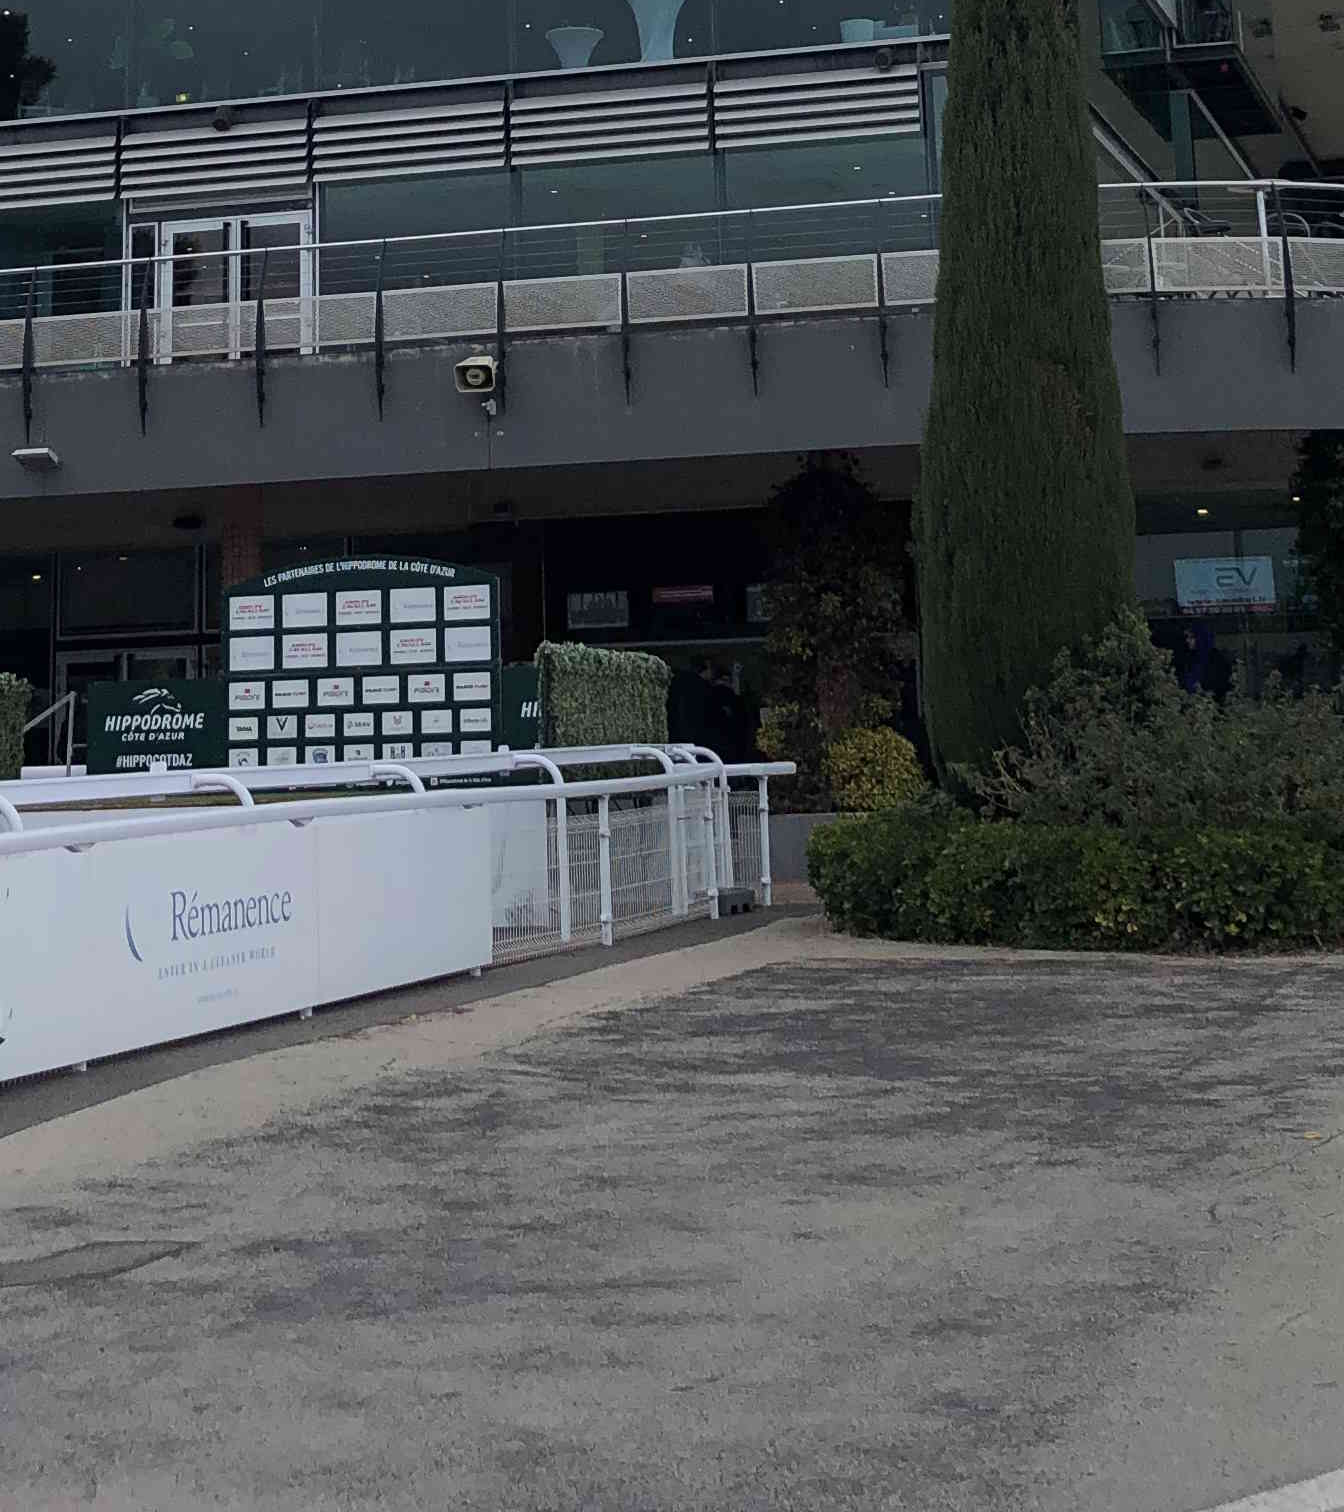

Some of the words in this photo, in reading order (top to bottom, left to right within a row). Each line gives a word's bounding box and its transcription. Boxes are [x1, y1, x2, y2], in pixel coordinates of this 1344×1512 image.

[263, 575, 277, 588] LES
[277, 564, 324, 582] PARTENAIRES
[325, 562, 335, 573] DE
[388, 560, 398, 570] DE
[399, 561, 409, 571] LA
[410, 561, 428, 573] CÔTE
[121, 731, 146, 742] CÔTE
[148, 731, 185, 742] D'AZUR
[170, 890, 292, 942] Rémanence
